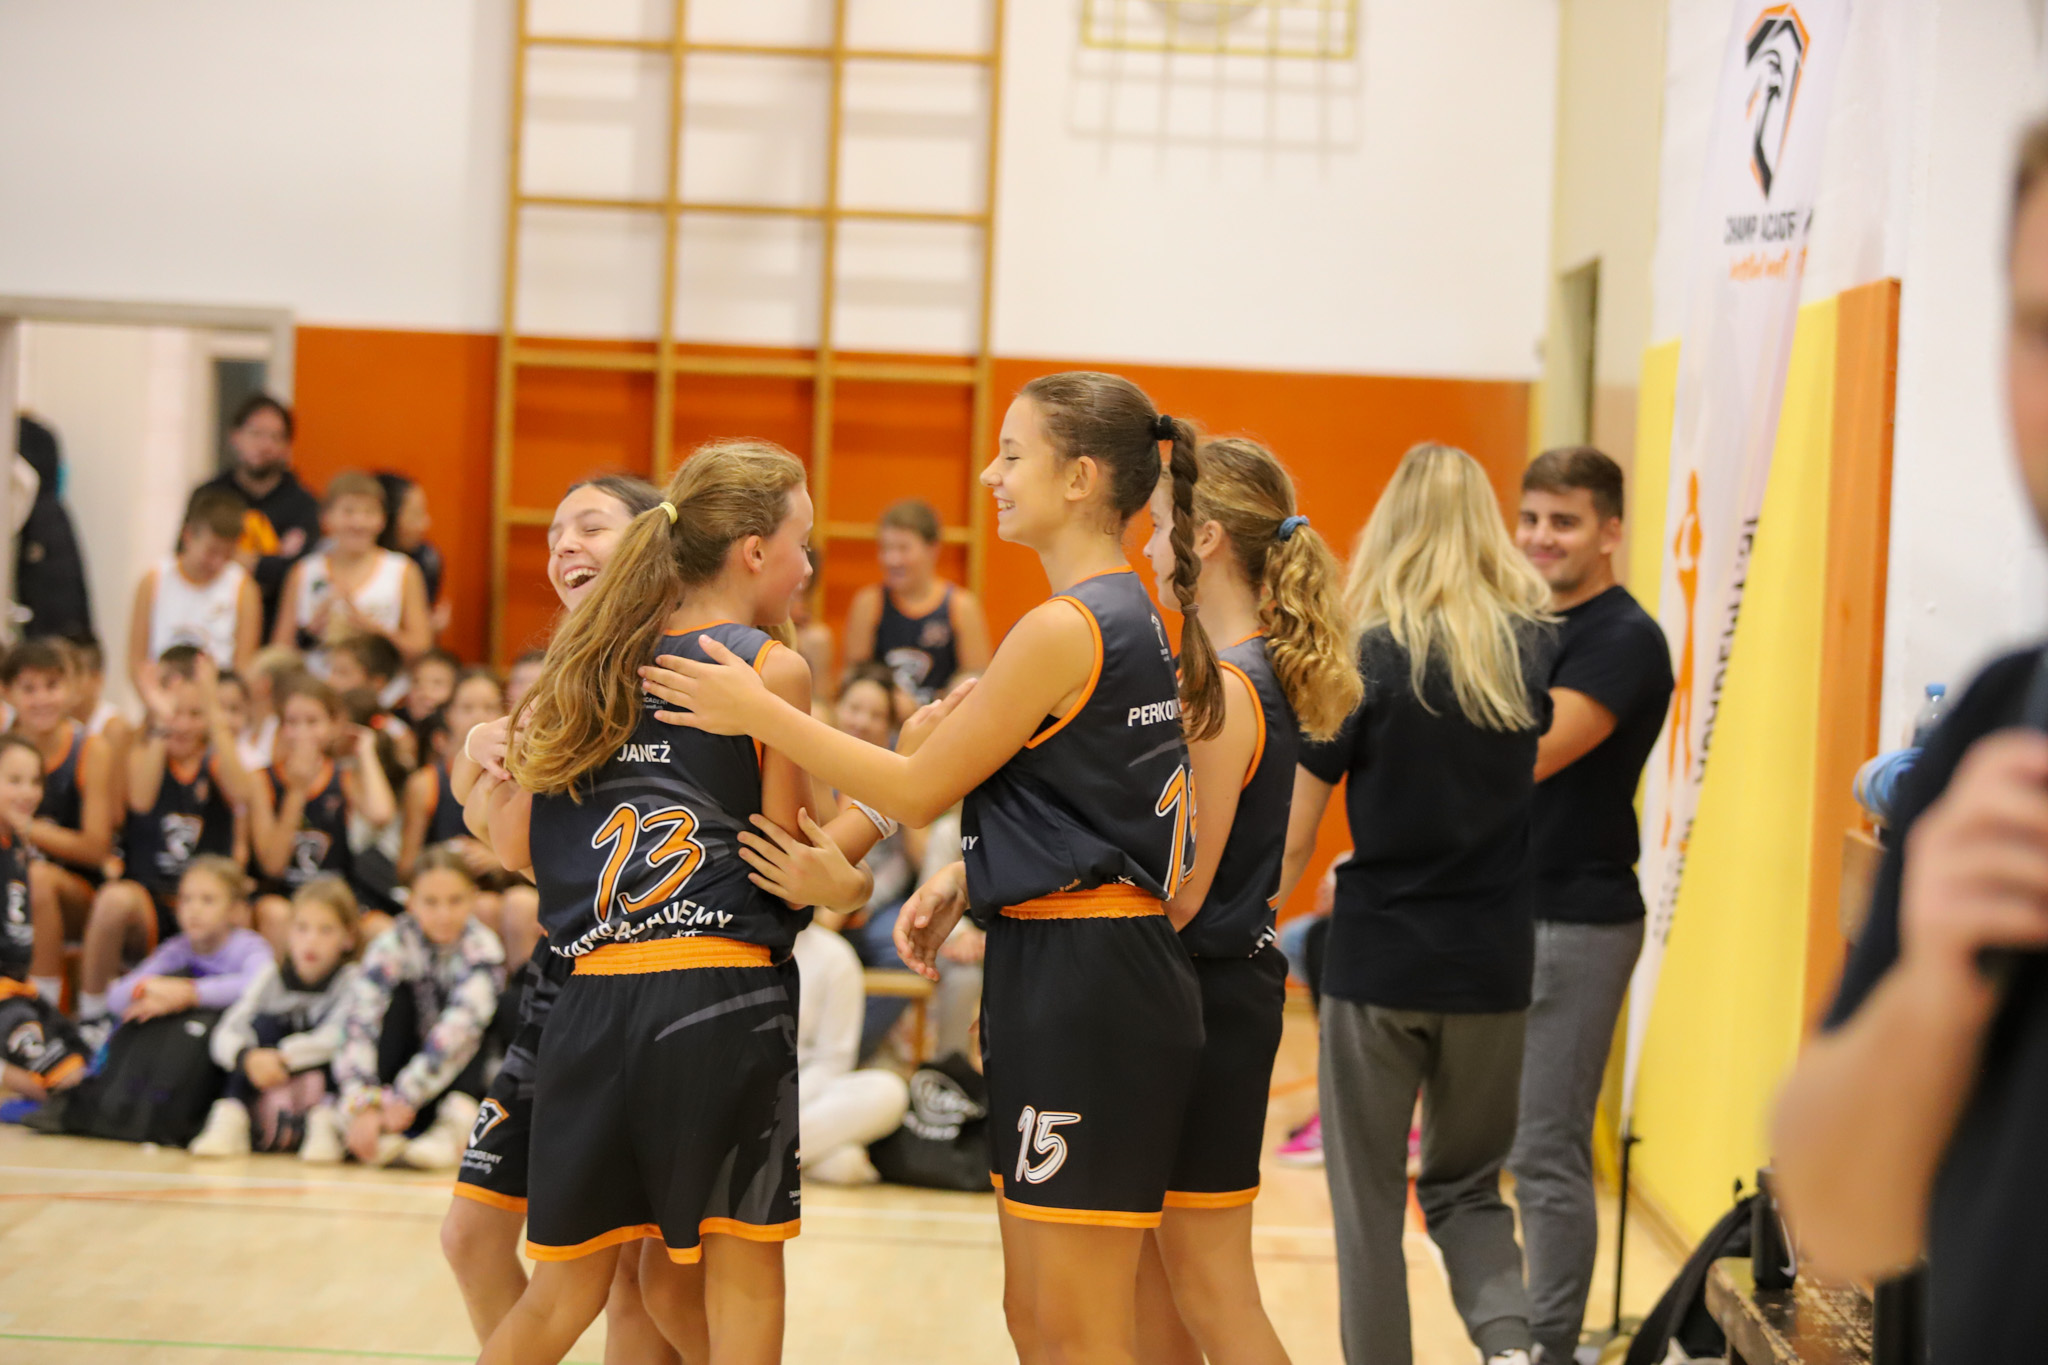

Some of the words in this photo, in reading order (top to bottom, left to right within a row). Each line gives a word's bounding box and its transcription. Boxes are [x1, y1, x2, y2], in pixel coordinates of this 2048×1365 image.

[616, 740, 671, 763] JANEŽ
[591, 802, 706, 924] 13
[1015, 1104, 1082, 1185] 15
